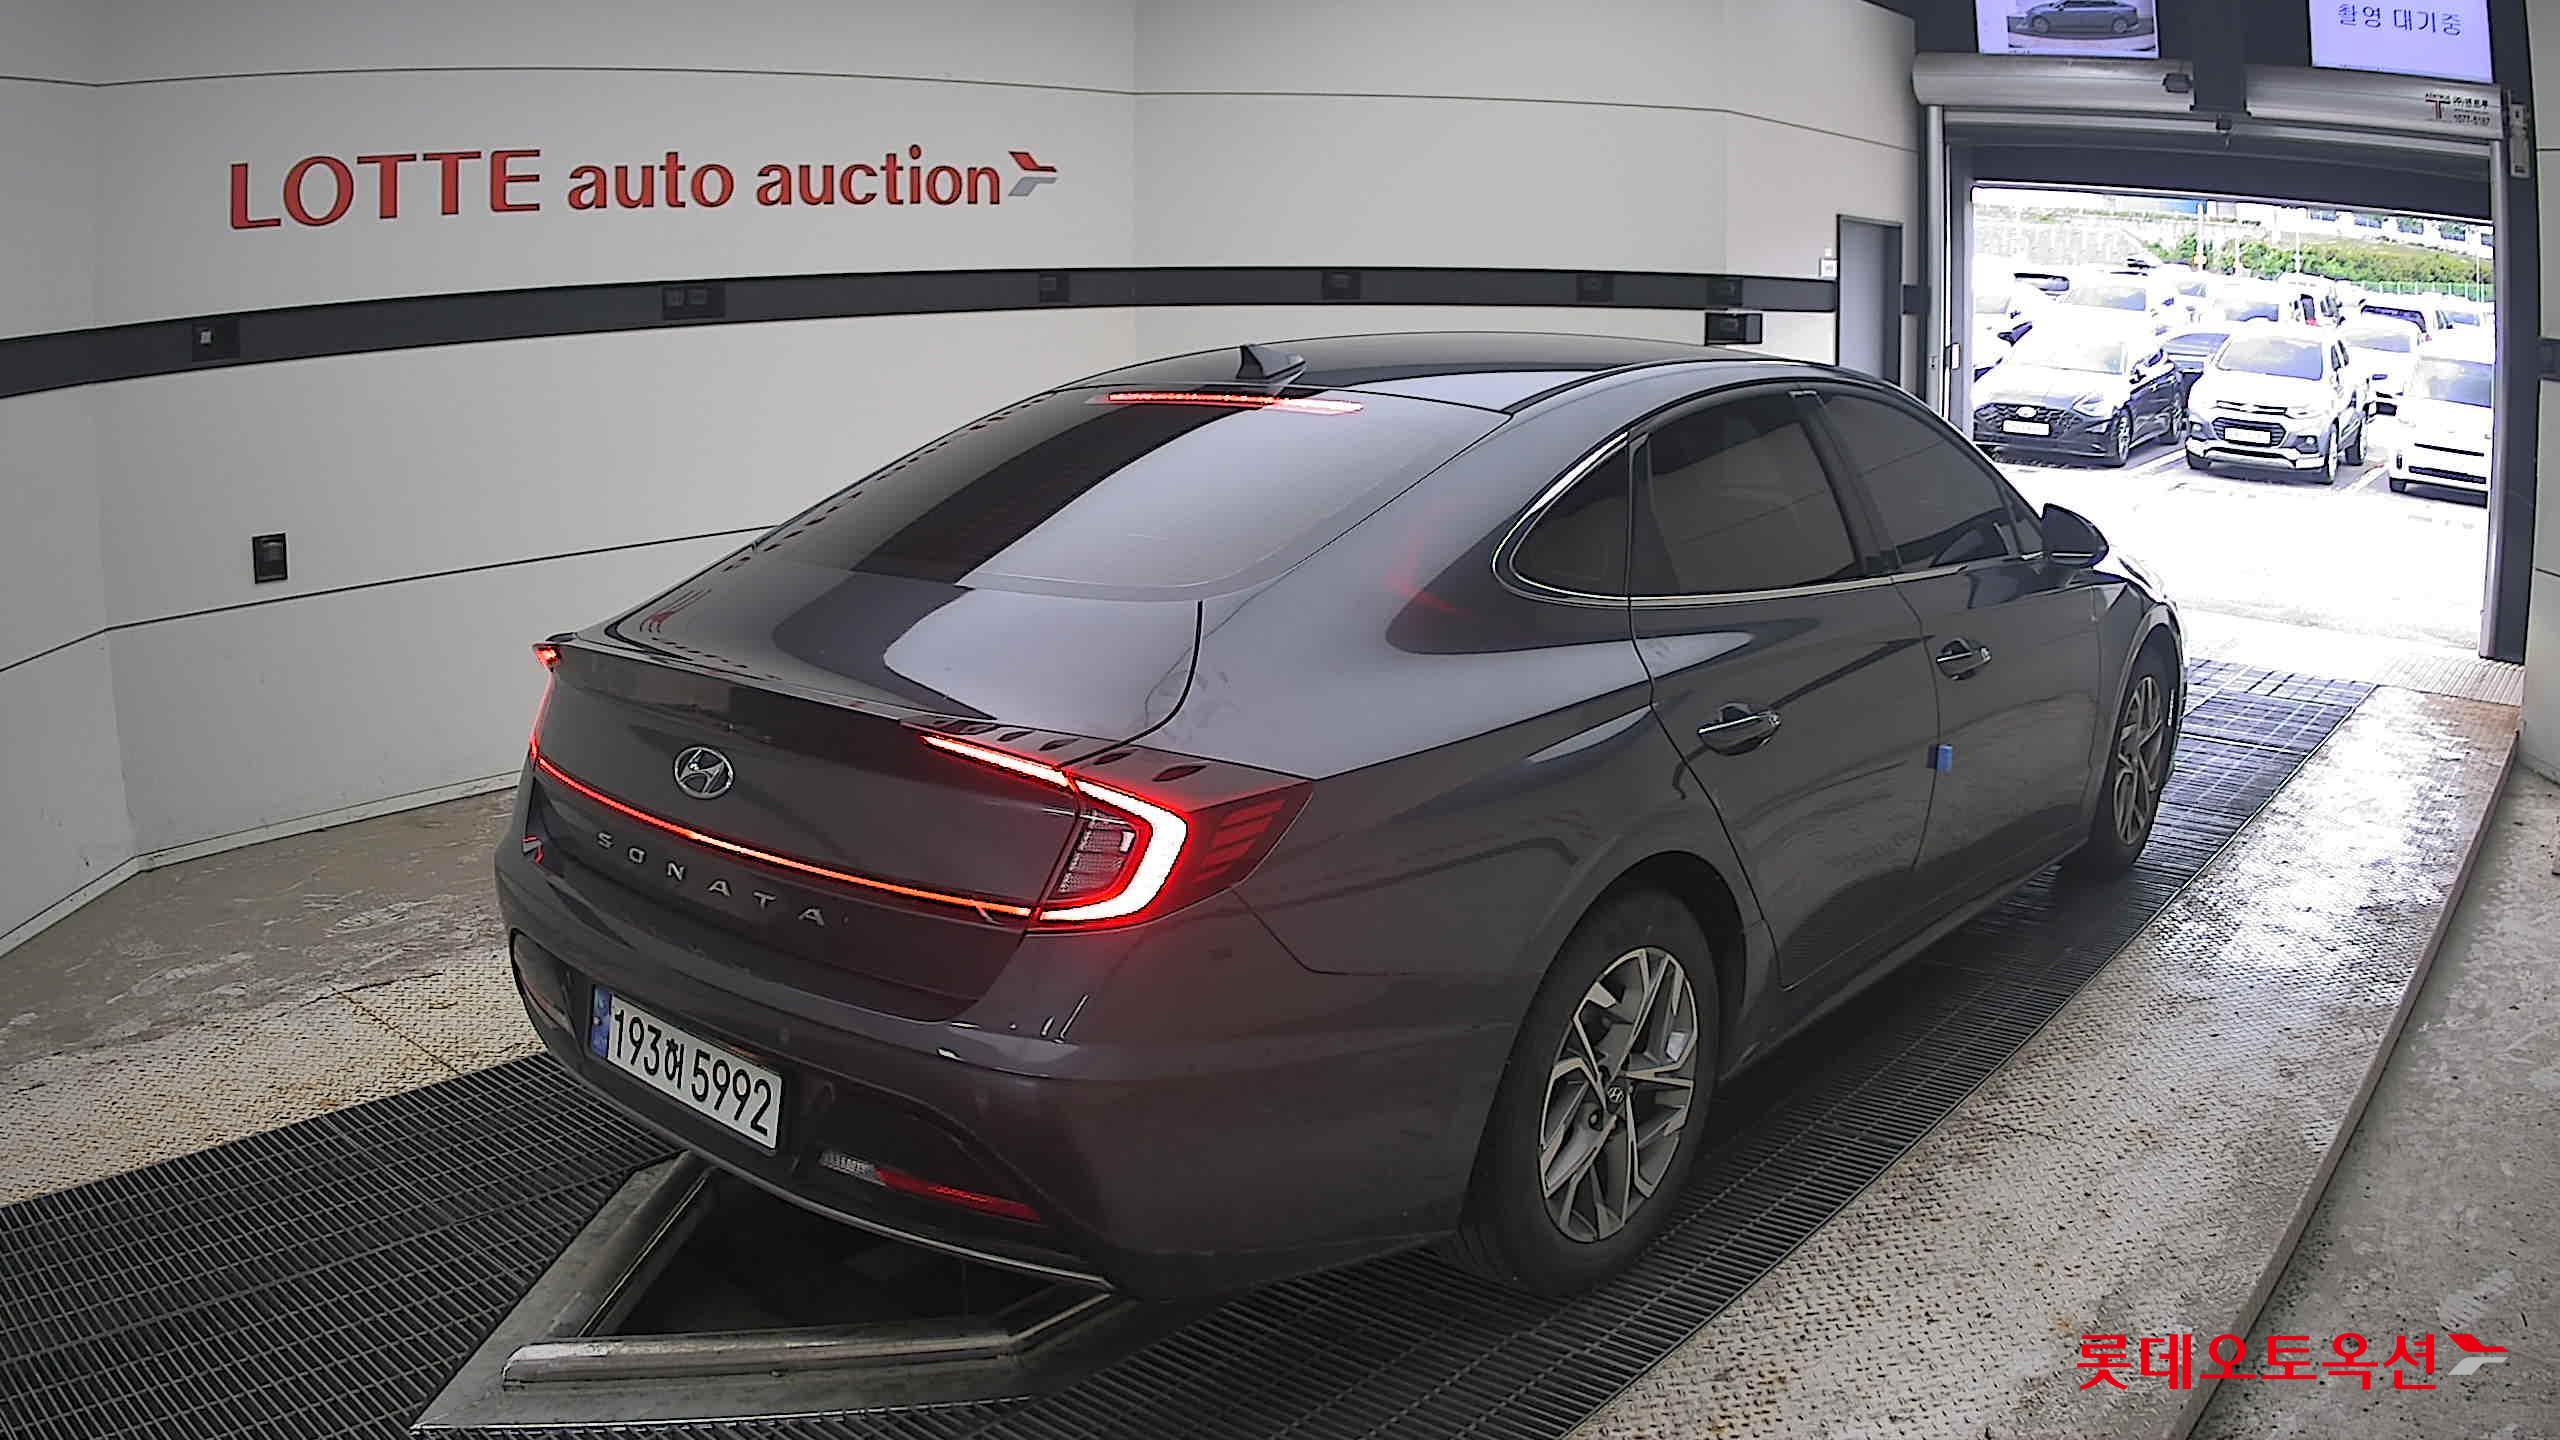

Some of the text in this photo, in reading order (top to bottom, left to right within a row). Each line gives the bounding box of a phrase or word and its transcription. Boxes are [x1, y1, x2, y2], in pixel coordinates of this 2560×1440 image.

[2337, 3, 2462, 37] 촬영 대기중
[230, 144, 1001, 230] LOTTE auto auction
[597, 831, 825, 927] SONATA
